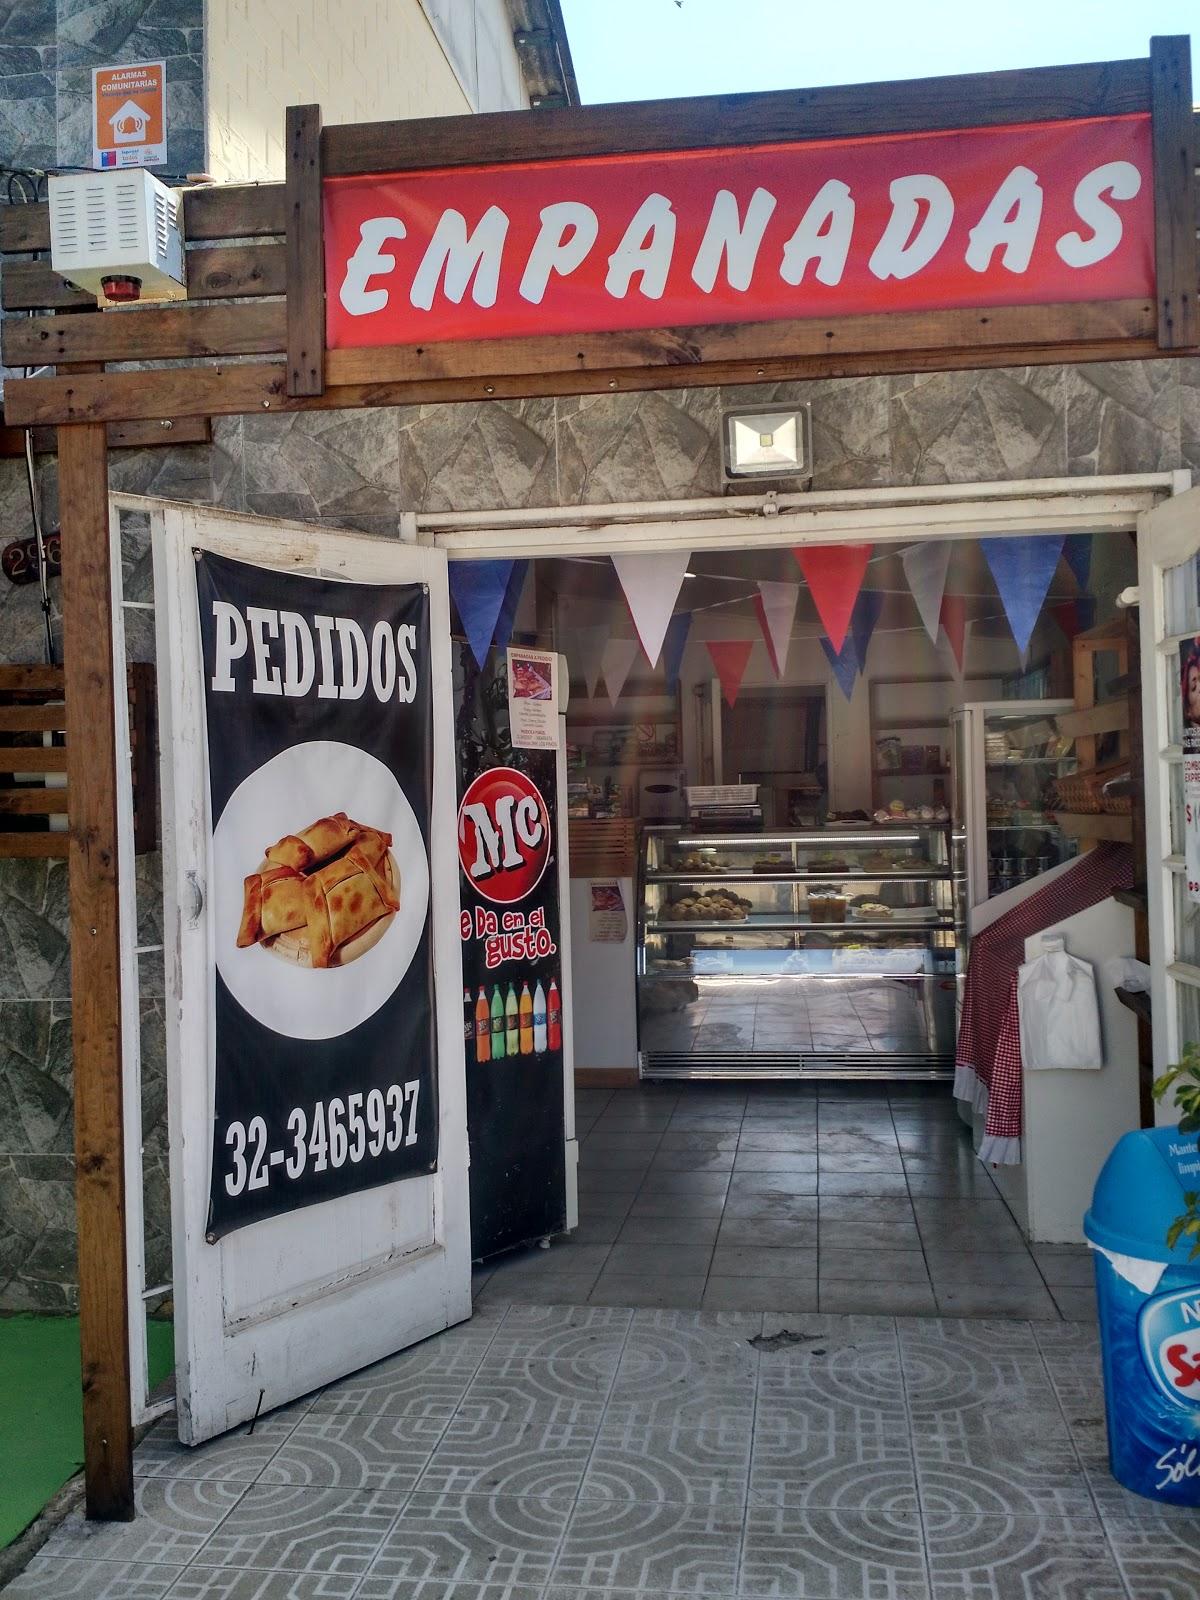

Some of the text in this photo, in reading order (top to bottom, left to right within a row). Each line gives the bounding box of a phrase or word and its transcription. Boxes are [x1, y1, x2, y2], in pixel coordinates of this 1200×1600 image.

[102, 79, 158, 92] COMUNITARIAS
[112, 71, 147, 81] ALARMAS
[339, 161, 1142, 317] EMPANADAS
[211, 600, 418, 704] PEDIDOS
[502, 911, 525, 931] en
[528, 906, 545, 928] el
[485, 924, 557, 969] gusto.
[225, 1079, 420, 1197] 32-3465937
[1168, 1143, 1198, 1157] Mante
